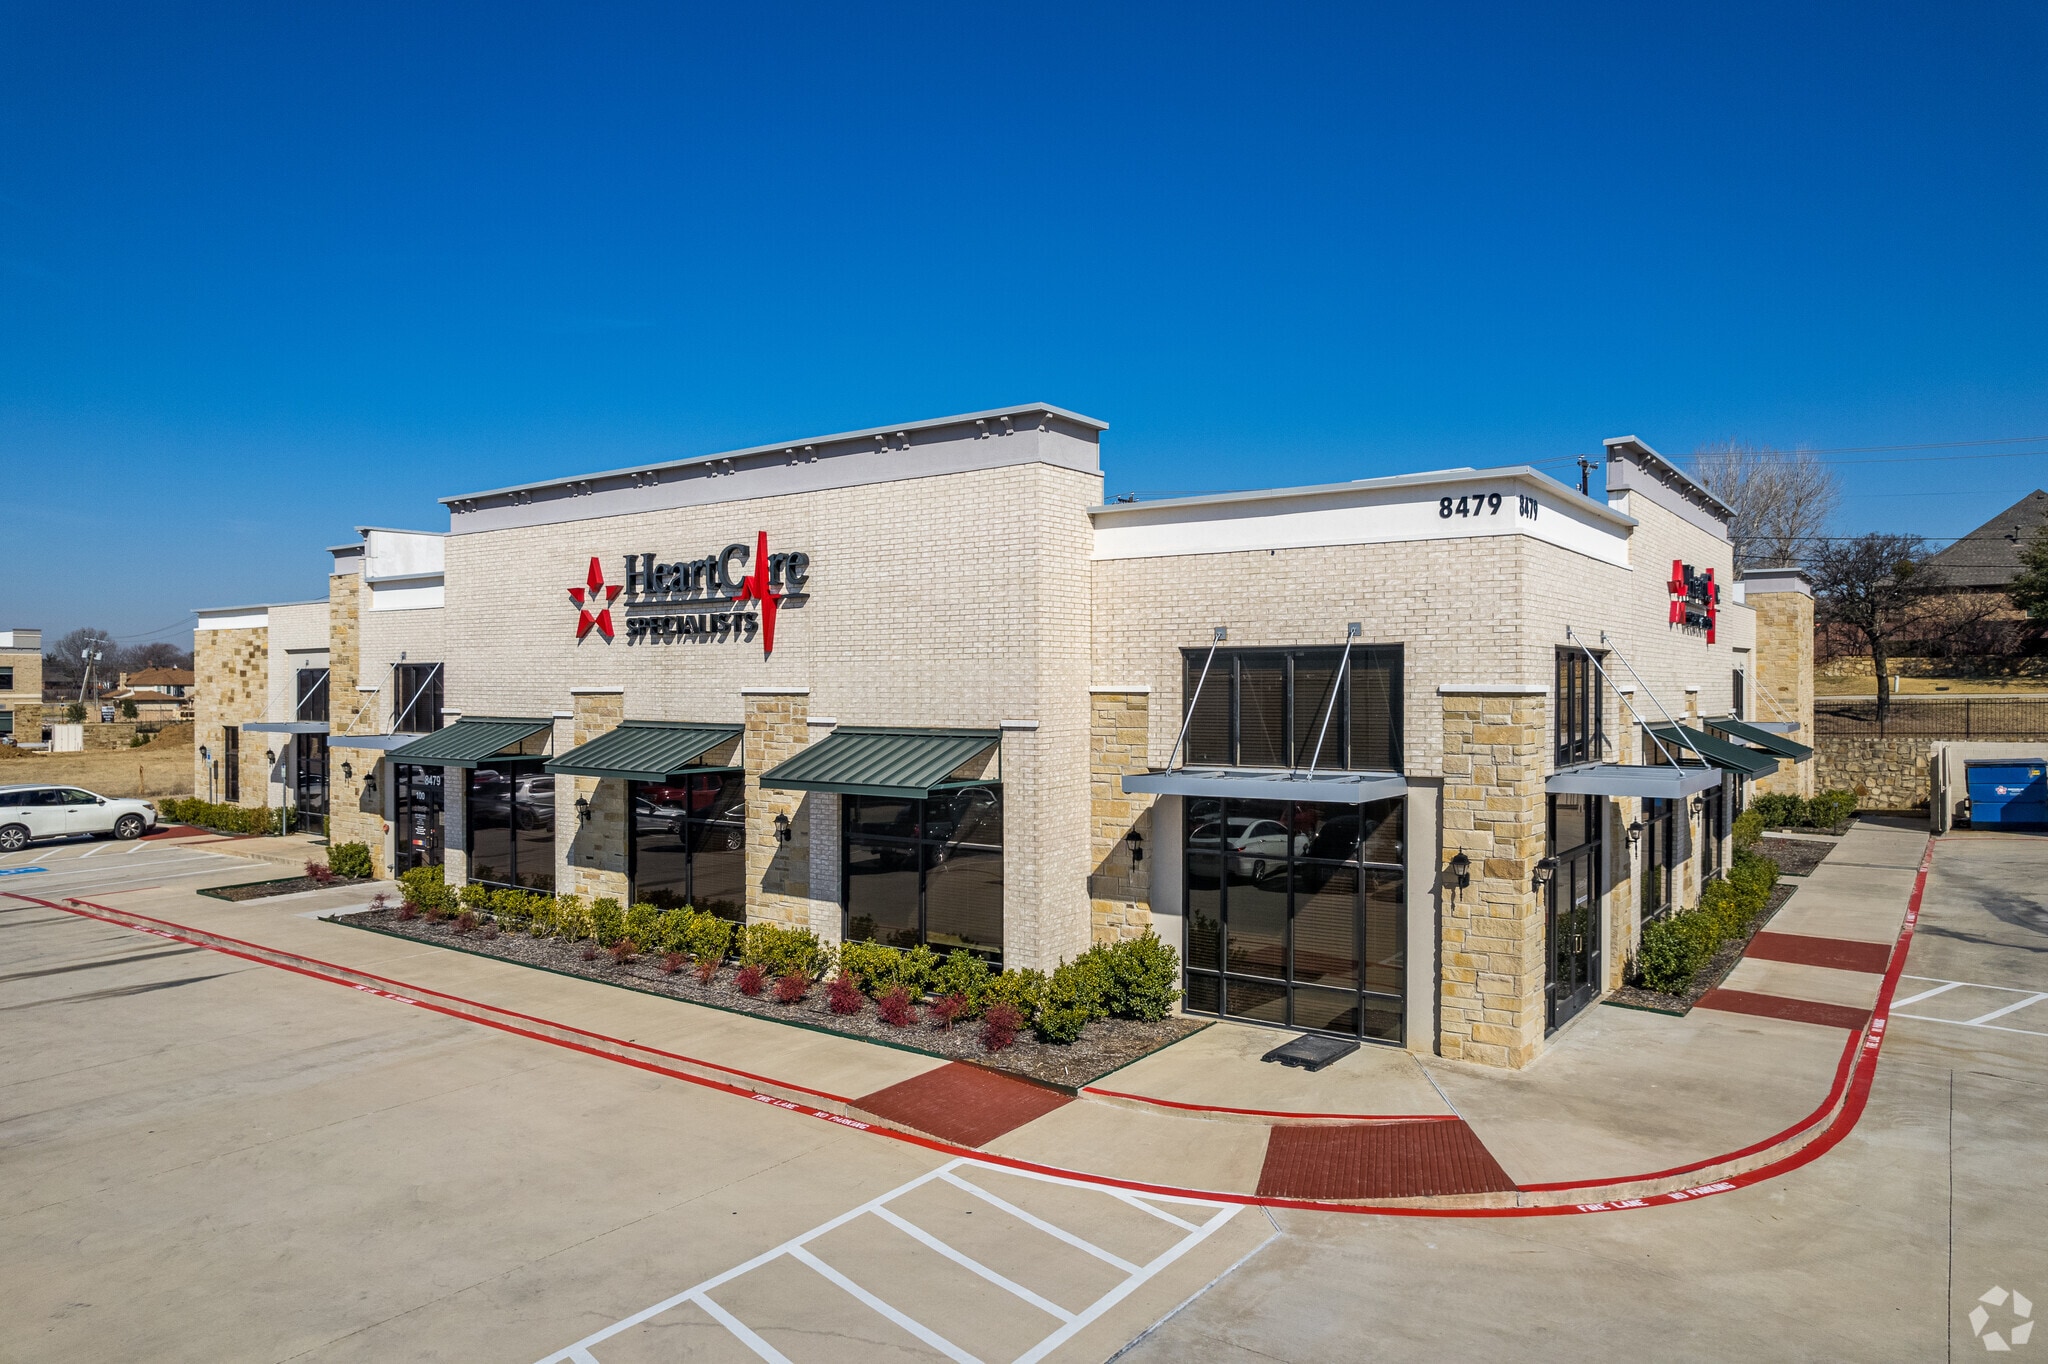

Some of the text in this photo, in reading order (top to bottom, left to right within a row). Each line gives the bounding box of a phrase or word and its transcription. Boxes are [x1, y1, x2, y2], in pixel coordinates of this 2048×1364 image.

[1439, 492, 1502, 519] 8479
[1519, 494, 1538, 521] 8479
[626, 612, 759, 636] SPECIALISTS
[424, 775, 441, 786] 8479
[415, 791, 426, 800] 100
[812, 1111, 829, 1119] NO
[828, 1116, 870, 1130] PARKING
[1667, 1191, 1689, 1200] NO
[1686, 1182, 1737, 1196] PARKING
